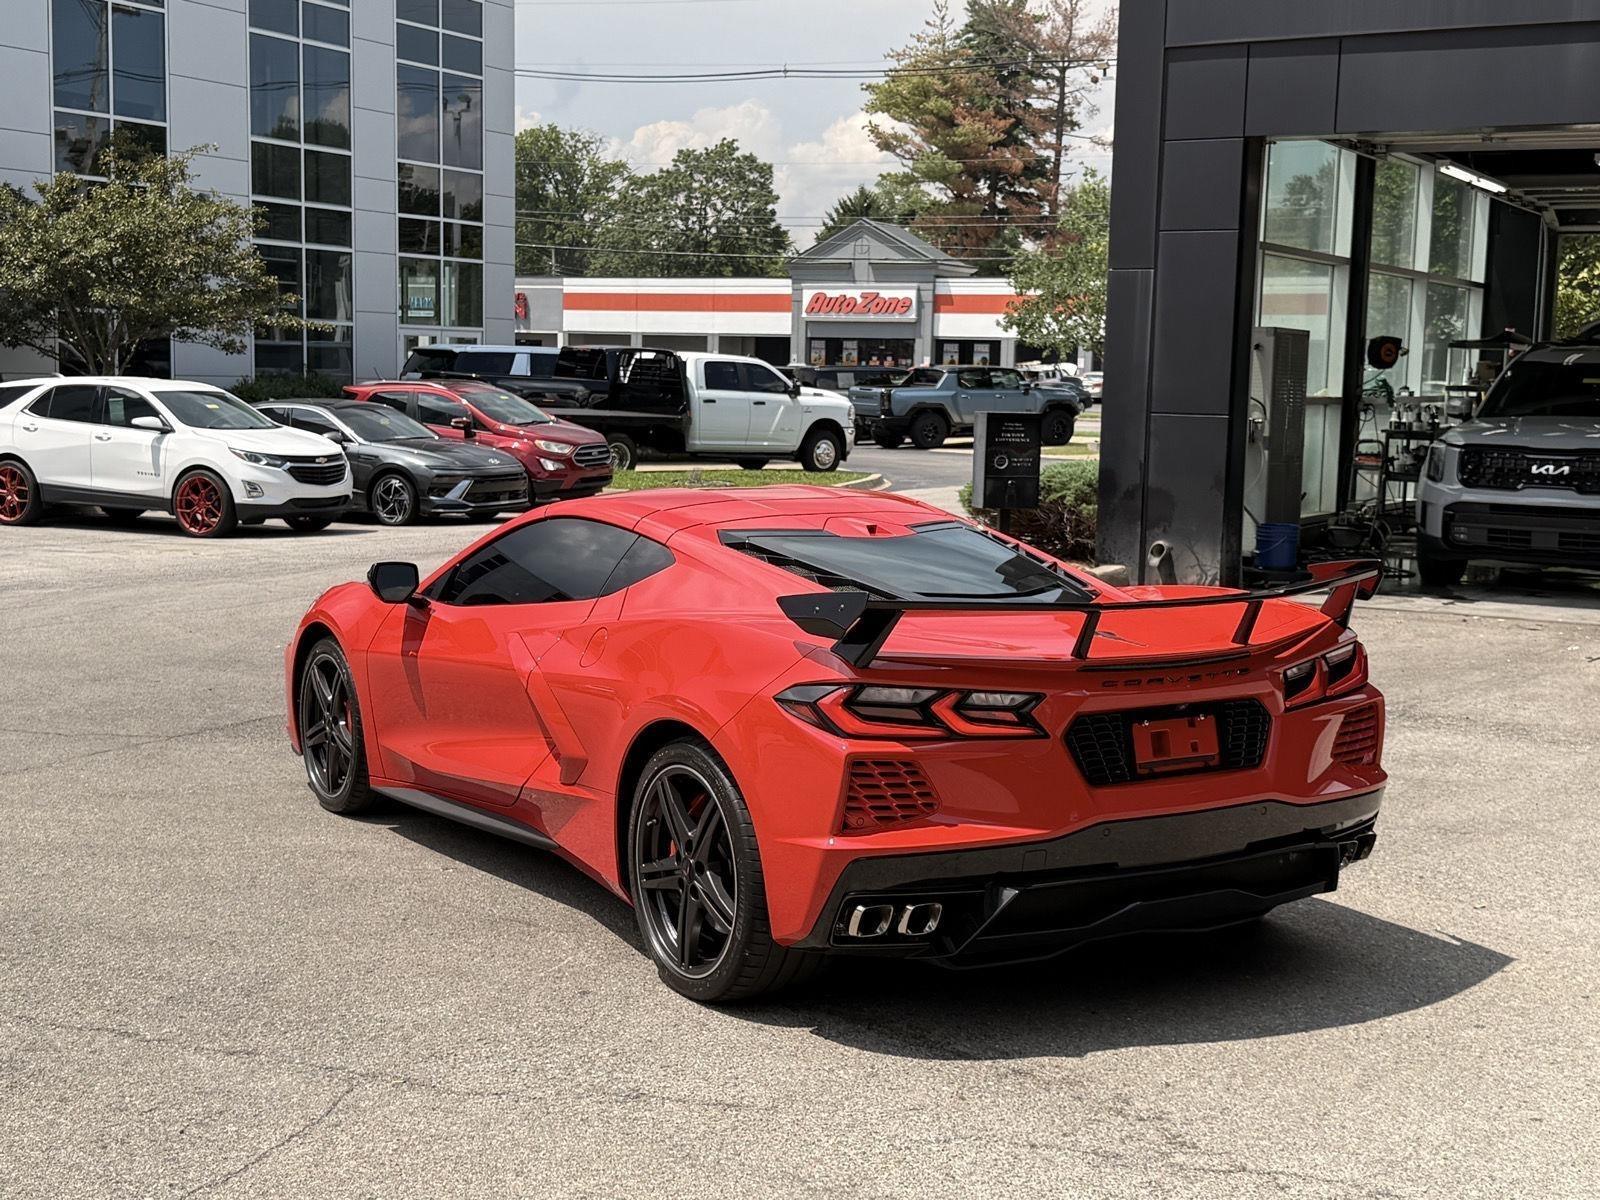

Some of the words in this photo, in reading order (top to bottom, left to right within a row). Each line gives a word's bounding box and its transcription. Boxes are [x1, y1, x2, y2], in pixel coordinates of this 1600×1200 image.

[805, 292, 913, 315] AutoZone
[1531, 464, 1570, 475] KIA
[1101, 668, 1250, 688] CORVETTE
